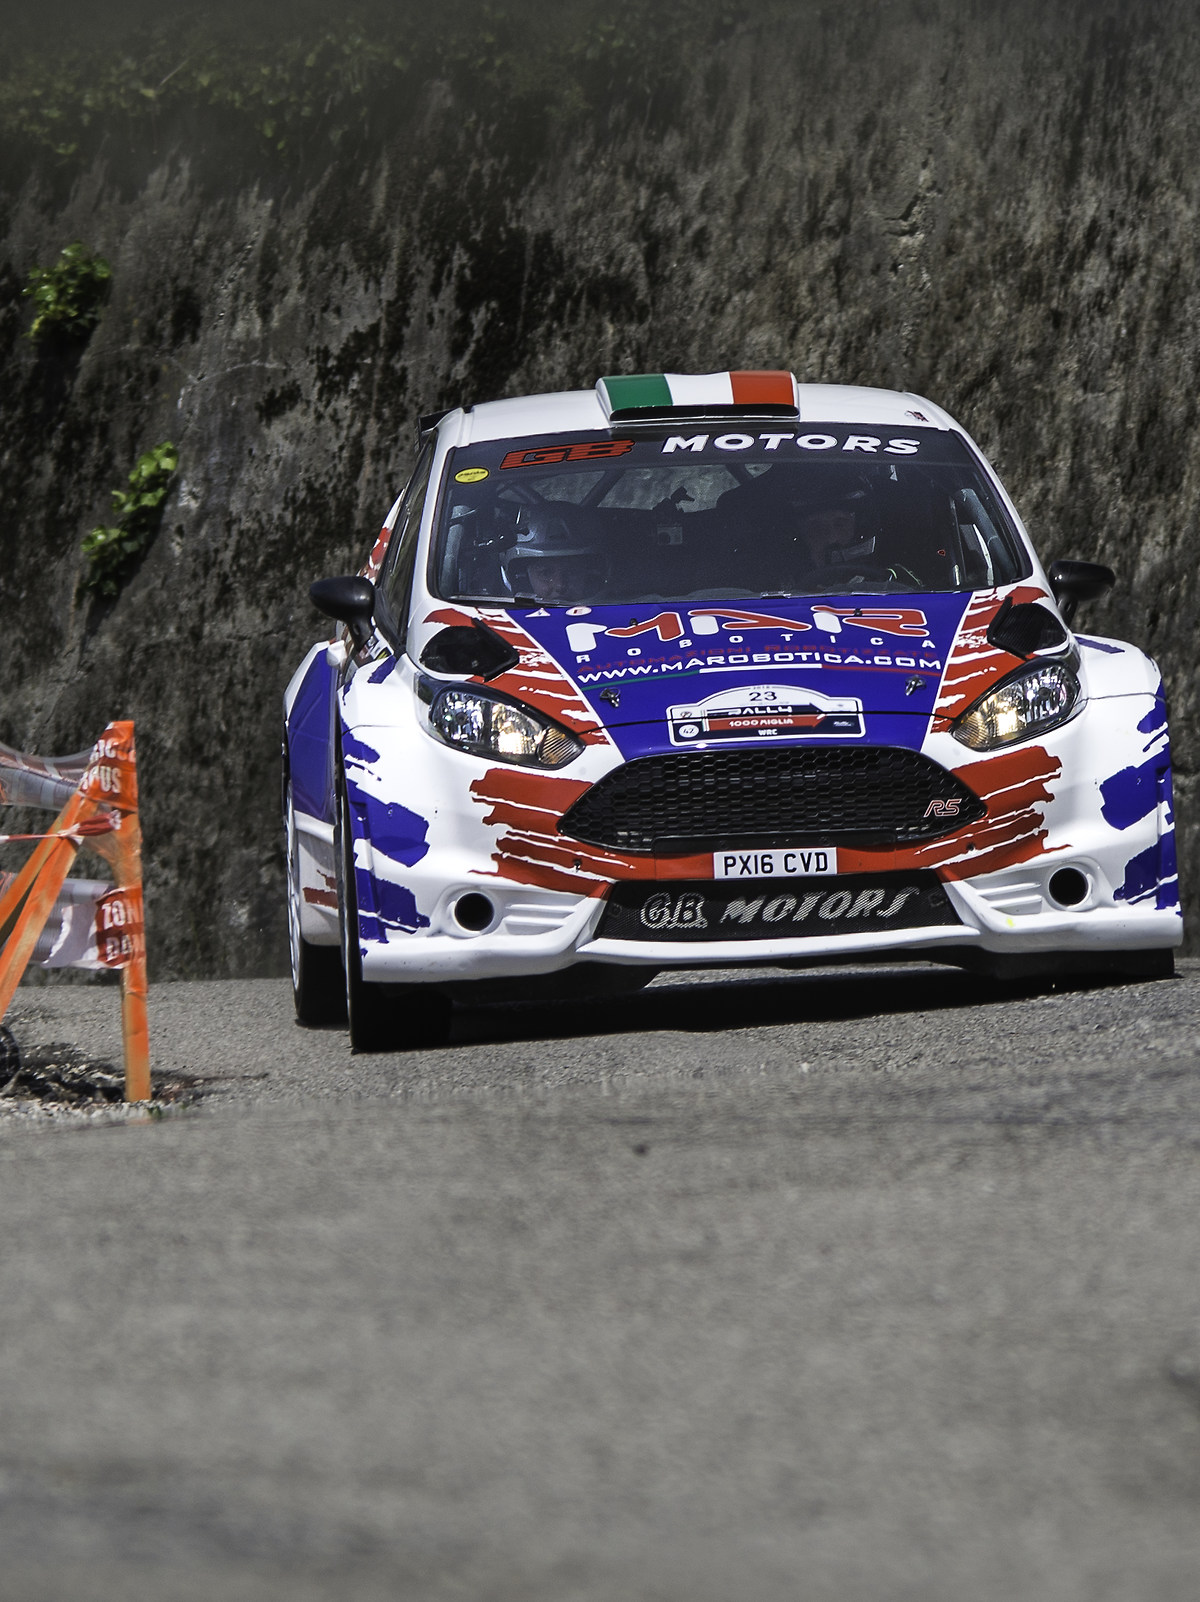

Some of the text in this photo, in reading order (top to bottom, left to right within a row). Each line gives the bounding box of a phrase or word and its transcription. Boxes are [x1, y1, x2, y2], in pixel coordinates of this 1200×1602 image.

[500, 433, 920, 470] GB MOTORS
[565, 604, 930, 653] MAR
[576, 633, 936, 664] ROBOTICA
[577, 652, 942, 684] WWW.MAROBOTICA.COM
[749, 690, 778, 702] 23
[726, 706, 793, 717] RALLY
[729, 718, 794, 727] 1000 MIGLIA
[757, 728, 778, 736] WRC
[923, 798, 962, 818] RS
[723, 851, 829, 876] PX16 CVD
[640, 886, 920, 930] GB MOTORS
